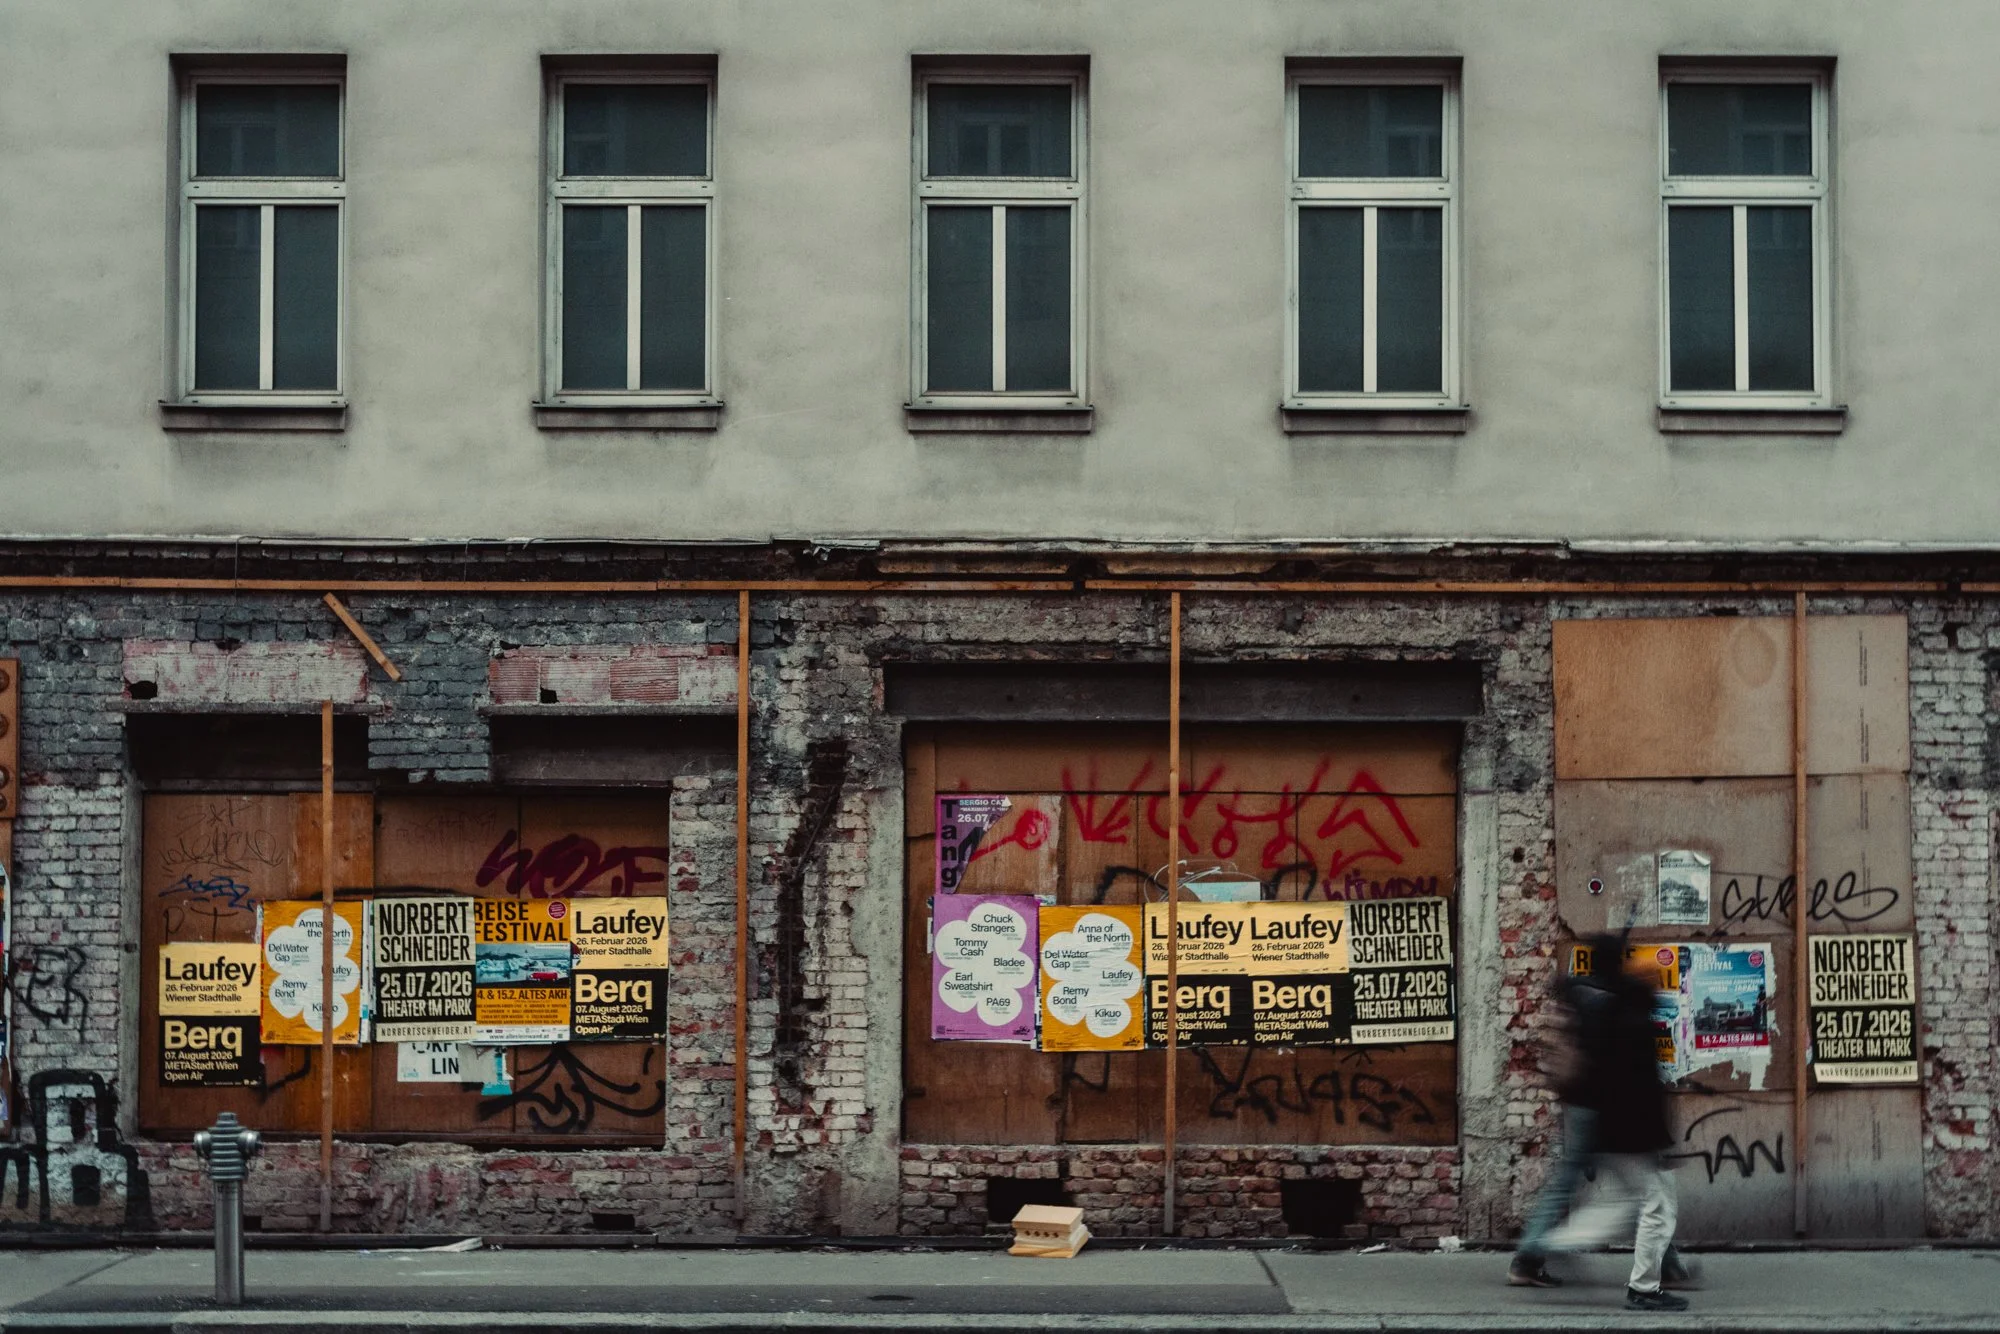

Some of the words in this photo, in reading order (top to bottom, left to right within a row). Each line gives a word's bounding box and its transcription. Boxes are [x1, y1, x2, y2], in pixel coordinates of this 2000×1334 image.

[474, 901, 529, 921] REISE
[298, 919, 323, 928] Anna
[379, 902, 470, 935] NORBERT
[983, 914, 1013, 924] Chuck
[1350, 901, 1442, 936] NORBERT
[576, 909, 665, 940] Laufey
[971, 924, 1016, 934] Strangers
[1078, 924, 1102, 933] Anna
[1104, 923, 1113, 932] of
[1251, 913, 1343, 945] Laufey
[307, 929, 322, 938] the
[332, 929, 351, 938] orth
[1087, 934, 1101, 943] the
[1103, 933, 1131, 942] North
[591, 937, 624, 945] Februar
[626, 937, 648, 945] 2026
[953, 938, 988, 949] Tommy
[1166, 942, 1201, 950] bruar
[1202, 942, 1224, 950] 2026
[1252, 943, 1264, 951] 26.
[1267, 942, 1301, 950] Februar
[1303, 941, 1325, 949] 2026
[268, 944, 282, 952] Del
[282, 944, 309, 952] Water
[380, 935, 471, 963] SCHNEIDER
[609, 947, 652, 956] Stadthalle
[960, 947, 984, 956] Cash
[1352, 934, 1445, 963] SCHNEIDER
[275, 954, 290, 964] Gap
[1044, 950, 1060, 959] Del
[1061, 950, 1089, 959] Water
[1152, 953, 1183, 961] Wier
[1185, 952, 1229, 961] Stadthalle
[1252, 953, 1283, 961] Wiener
[1285, 951, 1329, 960] Stadthalle
[1814, 938, 1907, 973] NORBERT
[993, 957, 1026, 967] Bladee
[1051, 960, 1071, 970] Gap
[165, 956, 257, 987] Laufey
[322, 966, 352, 976] ufey
[1102, 970, 1134, 981] Laufey
[955, 972, 973, 981] Earl
[165, 984, 178, 992] 26.
[180, 984, 214, 992] Februar
[216, 984, 238, 992] 2026
[282, 980, 307, 991] Remy
[380, 971, 472, 999] 25.07.2026
[944, 982, 993, 991] Sweatshirt
[1353, 971, 1448, 1000] 25.07.2026
[1816, 973, 1909, 1001] SCHNEIDER
[275, 989, 295, 998] Bond
[476, 989, 485, 999] 4.
[487, 989, 495, 999] &
[518, 989, 547, 999] ALTES
[548, 989, 567, 999] AKH
[575, 974, 653, 1010] Berq
[1062, 987, 1089, 998] Remy
[165, 994, 196, 1002] Wiener
[198, 993, 242, 1002] Stadthalle
[986, 998, 1011, 1007] PA69
[1053, 996, 1077, 1005] Bond
[1252, 980, 1332, 1015] Berq
[312, 1003, 338, 1012] Kio
[381, 999, 427, 1018] THEATER
[428, 999, 443, 1017] IM
[444, 998, 473, 1016] PARK
[575, 1005, 587, 1014] 07.
[589, 1004, 620, 1016] August
[621, 1005, 643, 1013] 2026
[1354, 1000, 1402, 1019] THEATER
[1403, 999, 1418, 1017] IM
[1420, 998, 1449, 1016] PARK
[1095, 1008, 1121, 1018] Kikuo
[1152, 1011, 1164, 1020] 07.
[1165, 1011, 1197, 1021] ugust
[1198, 1011, 1221, 1020] 2026
[1253, 1012, 1266, 1020] 07.
[1267, 1010, 1299, 1022] August
[1300, 1010, 1322, 1019] 2026
[575, 1014, 625, 1024] METAStadt
[626, 1015, 649, 1023] Wien
[1152, 1020, 1202, 1030] MEStadt
[1204, 1020, 1227, 1029] Wien
[1254, 1020, 1305, 1030] METAStadt
[1306, 1019, 1329, 1029] Wien
[1816, 1010, 1912, 1039] 25.07.2026
[381, 1026, 473, 1037] NORBERTSCHNEIDER.AT
[575, 1025, 599, 1036] Open
[1356, 1026, 1449, 1038] NORBERTSCHNEIDER.AT
[165, 1020, 243, 1057] Berq
[1152, 1031, 1171, 1042] Op
[1178, 1031, 1192, 1040] Air
[1254, 1032, 1279, 1043] Open
[1281, 1031, 1294, 1041] Air
[1816, 1038, 1864, 1059] THEATER
[1866, 1038, 1881, 1056] IM
[1883, 1037, 1912, 1057] PARK
[165, 1051, 177, 1060] 07.
[178, 1051, 210, 1062] August
[211, 1051, 233, 1060] 2026
[165, 1061, 214, 1070] METAStadt
[215, 1061, 239, 1070] Wien
[165, 1071, 188, 1082] Open
[190, 1071, 204, 1080] Air
